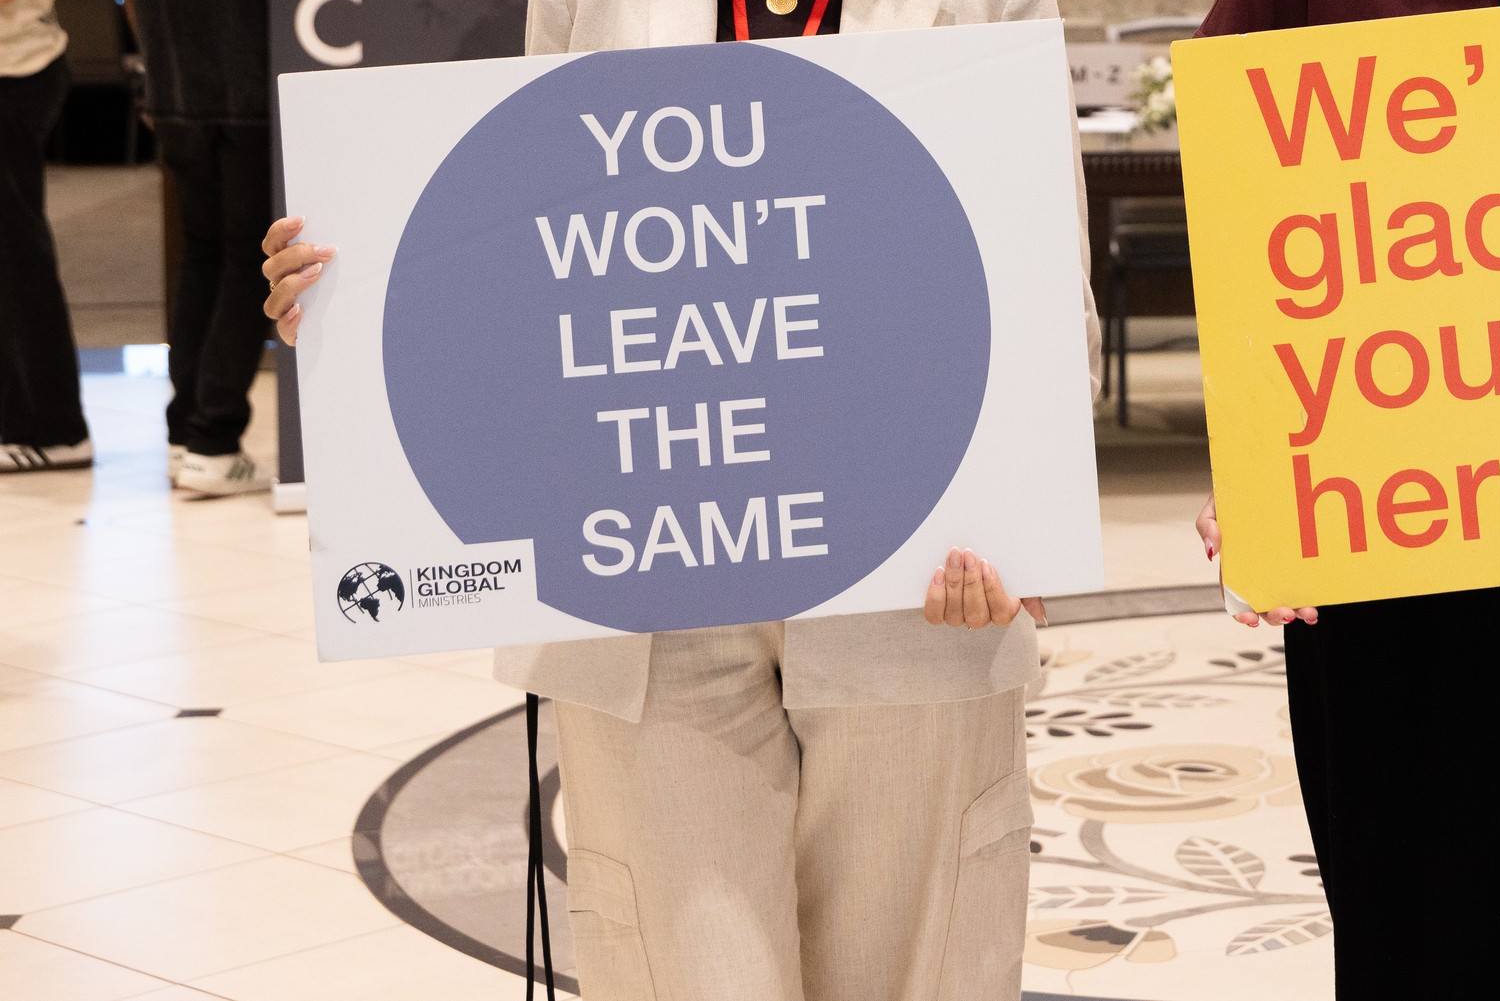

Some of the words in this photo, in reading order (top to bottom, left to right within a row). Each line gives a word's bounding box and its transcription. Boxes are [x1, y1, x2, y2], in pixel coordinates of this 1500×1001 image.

[579, 101, 765, 176] YOU
[535, 194, 827, 280] WON’T
[559, 293, 824, 379] LEAVE
[597, 397, 771, 474] THE
[416, 558, 522, 582] KINGDOM
[581, 491, 829, 577] SAME
[417, 576, 506, 597] GLOBAL
[418, 592, 482, 609] MINISTRIES
